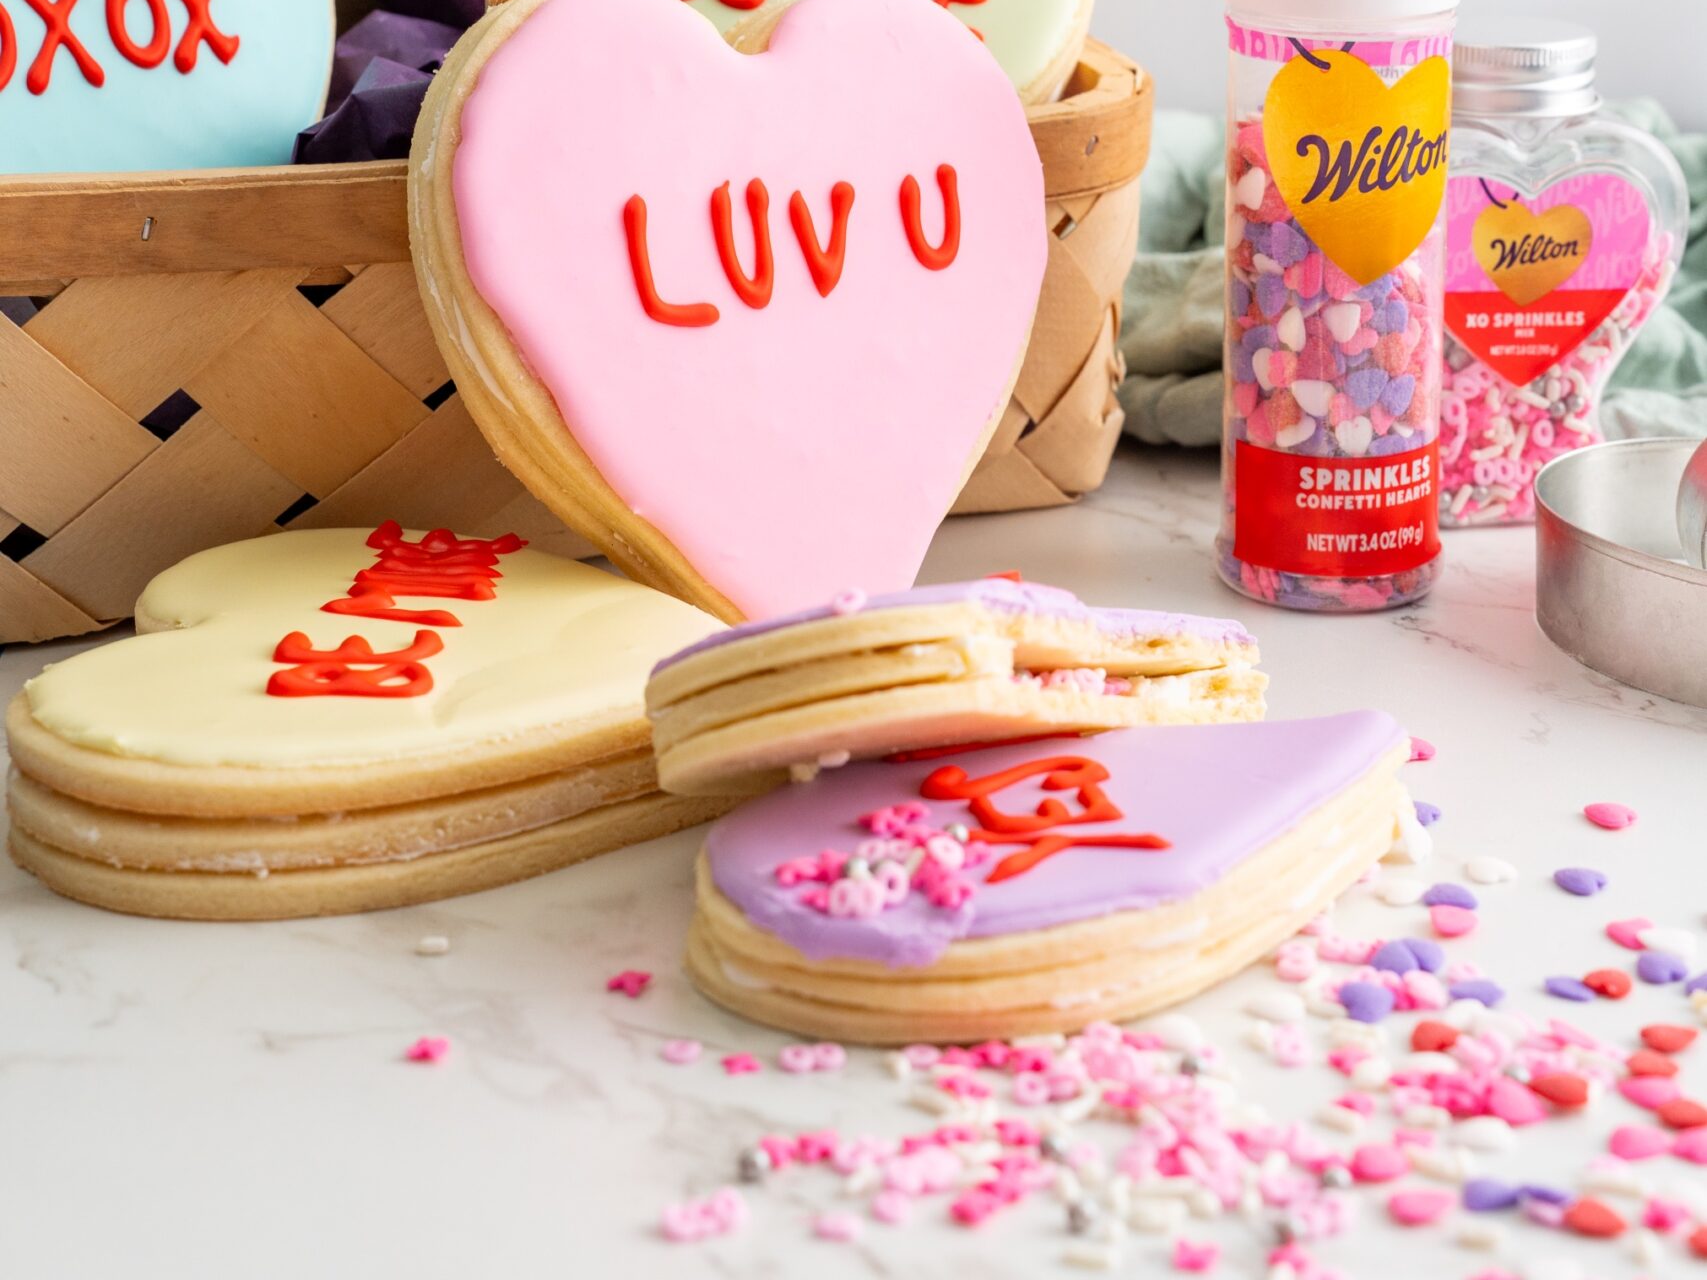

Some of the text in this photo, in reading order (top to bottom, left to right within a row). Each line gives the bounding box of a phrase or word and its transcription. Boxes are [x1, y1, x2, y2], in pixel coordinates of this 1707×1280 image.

[1296, 125, 1448, 205] Wilton
[621, 162, 962, 328] LUV U
[1490, 233, 1578, 272] Wilton
[1465, 310, 1586, 329] XO SPRINKLES
[1298, 454, 1431, 492] SPRINKLES
[1295, 480, 1432, 510] CONFETTI HEARTS
[1306, 532, 1334, 552] NET
[1335, 533, 1358, 553] WT
[1359, 532, 1378, 552] 3.4
[1379, 529, 1397, 550] OZ
[265, 628, 445, 699] BE
